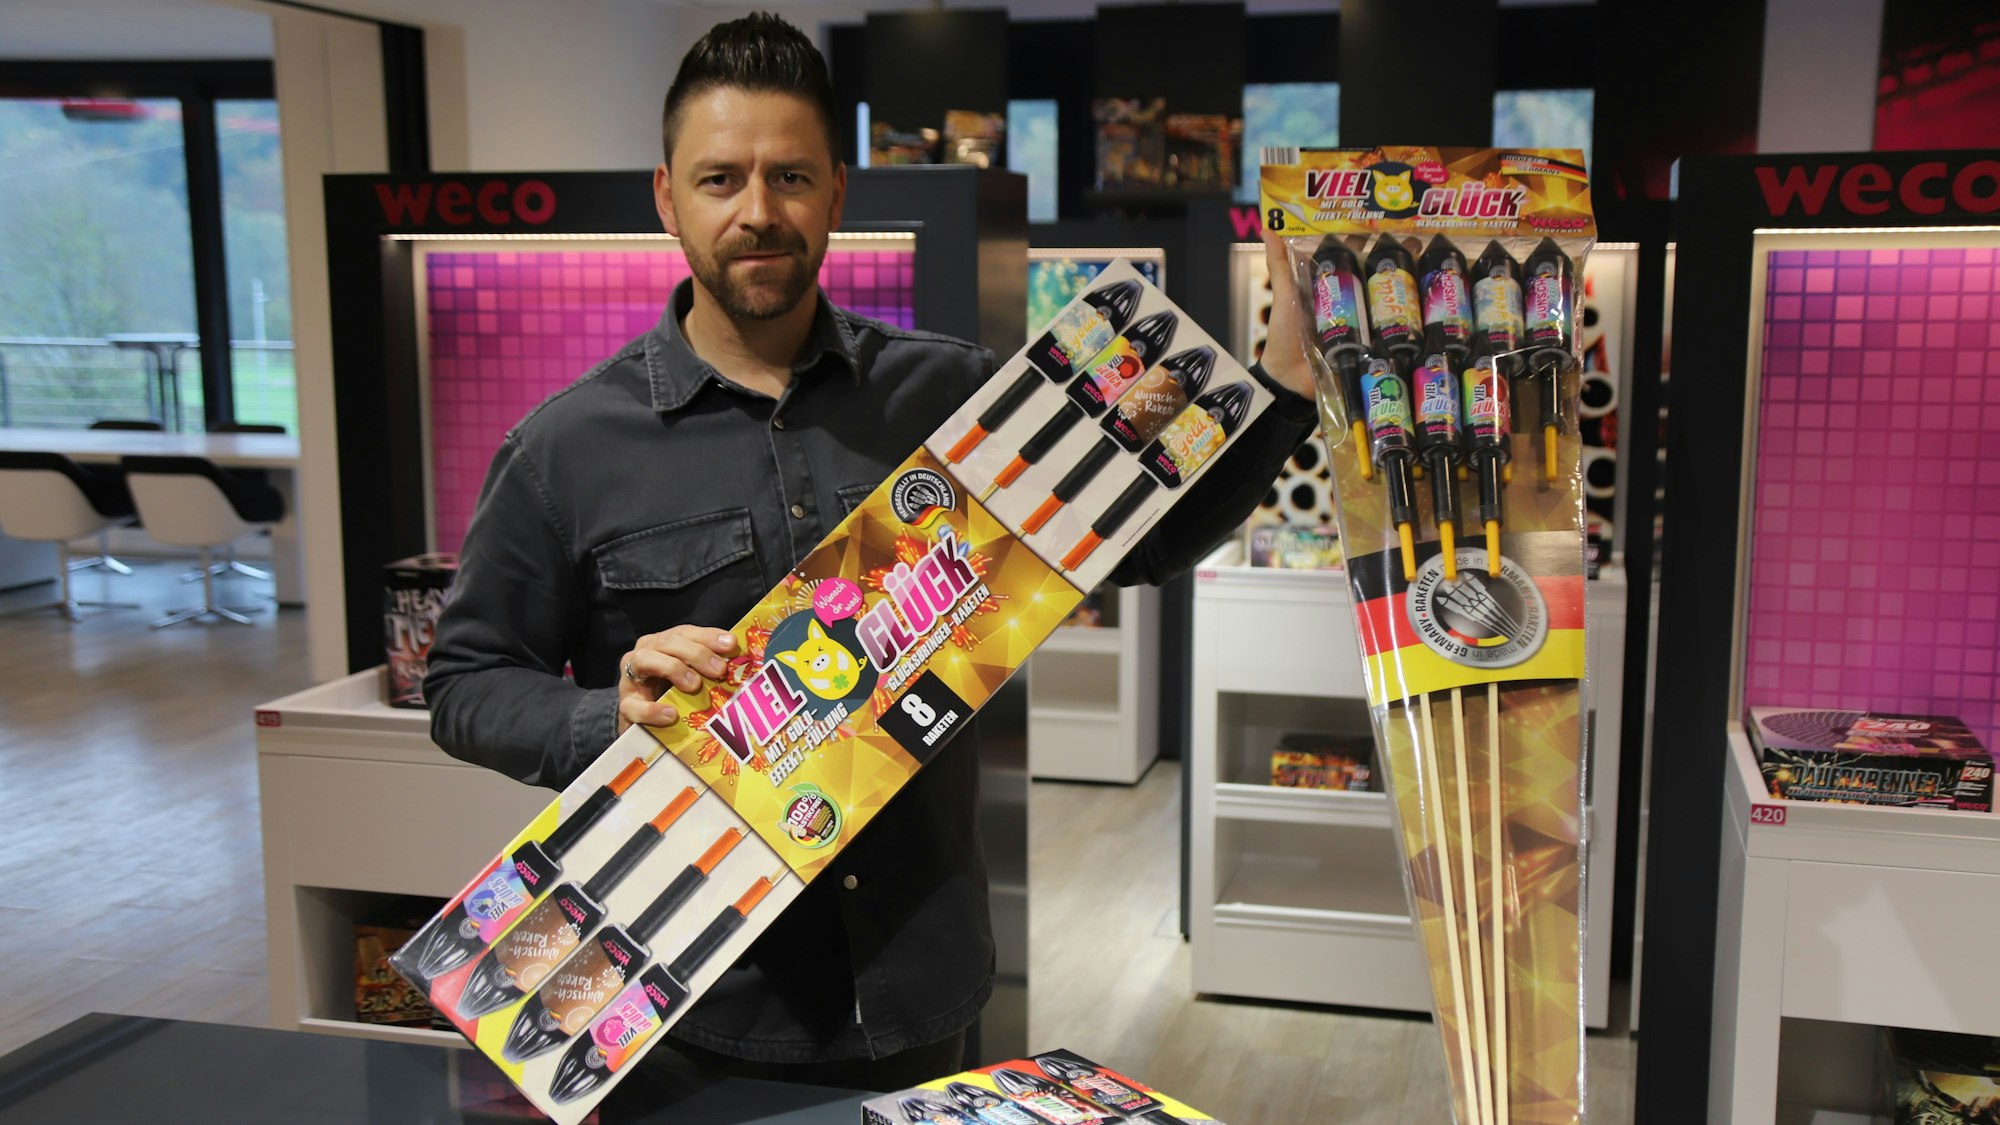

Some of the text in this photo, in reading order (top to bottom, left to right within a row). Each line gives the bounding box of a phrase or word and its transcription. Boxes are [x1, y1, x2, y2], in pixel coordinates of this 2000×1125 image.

[1305, 169, 1526, 219] VIEL GLÜCK
[1755, 160, 2000, 216] weco
[375, 180, 557, 226] weco
[1267, 208, 1285, 230] 8
[1528, 217, 1585, 230] weco
[1442, 273, 1457, 316] WUNSCH
[1535, 276, 1548, 320] WUNSCH
[1107, 354, 1124, 369] VIEL
[1083, 381, 1105, 403] weco
[1369, 387, 1382, 407] VIEL
[1424, 382, 1437, 401] VIEL
[1473, 384, 1487, 402] VIEL
[1369, 399, 1405, 419] GLÜCK
[1421, 397, 1458, 415] GLÜCK
[1115, 419, 1137, 441] weco
[1157, 454, 1178, 474] weco
[894, 472, 950, 519] HERGESTELLT IN DEUTSCHLAND
[1415, 568, 1440, 612] RAKETEN
[1474, 556, 1484, 566] in
[832, 603, 844, 615] dir
[856, 532, 979, 673] GLÜCK
[887, 583, 991, 692] GLÜCKSBRINGER-RAKETEN
[1418, 606, 1538, 660] RAKETEN made in GERMANY
[704, 659, 808, 767] VIEL
[901, 693, 937, 727] 8
[763, 708, 818, 765] MIT GOLD-
[922, 709, 959, 747] RAKETEN
[769, 702, 849, 788] EFFEKT-FÜLLUNG
[1966, 766, 1991, 779] 240
[787, 792, 817, 826] 100%
[1752, 807, 1785, 823] 420
[515, 861, 539, 886] weco
[488, 877, 525, 908] GLÜCK
[489, 902, 509, 921] VIEL
[560, 897, 586, 923] weco
[604, 940, 632, 966] weco
[645, 984, 669, 1008] weco
[616, 1001, 653, 1032] GLÜCK
[617, 1026, 637, 1049] VIEL
